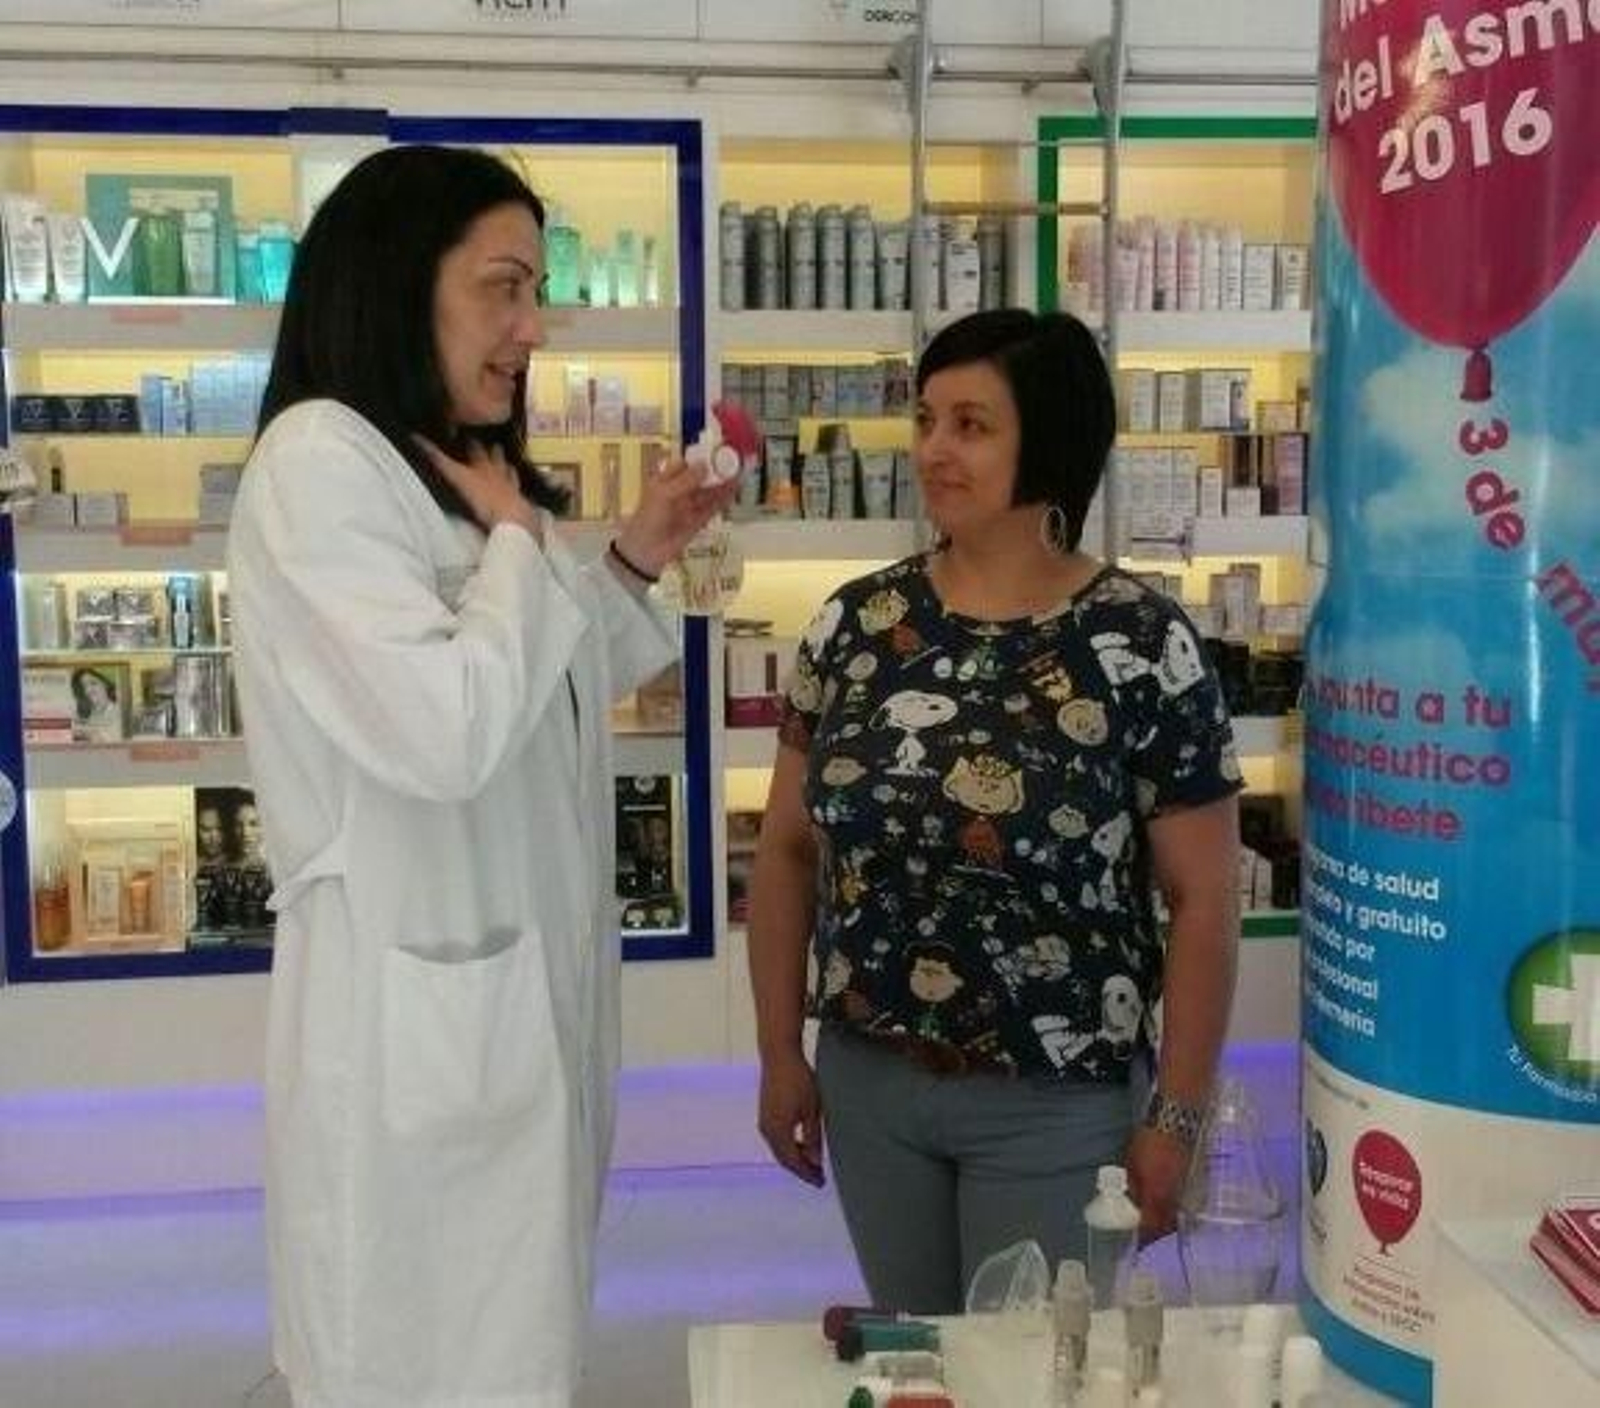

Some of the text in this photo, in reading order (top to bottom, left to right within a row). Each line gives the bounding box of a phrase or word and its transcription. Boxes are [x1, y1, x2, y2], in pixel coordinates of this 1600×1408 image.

[1334, 35, 1394, 125] del
[1377, 87, 1553, 195] 2016
[1459, 418, 1509, 455] 3
[1465, 471, 1526, 550] de
[1415, 692, 1446, 725] a
[1465, 684, 1512, 729] tu
[1347, 862, 1370, 887] de
[1373, 871, 1440, 901] salud
[1357, 904, 1447, 941] gratuito
[1345, 938, 1376, 962] por
